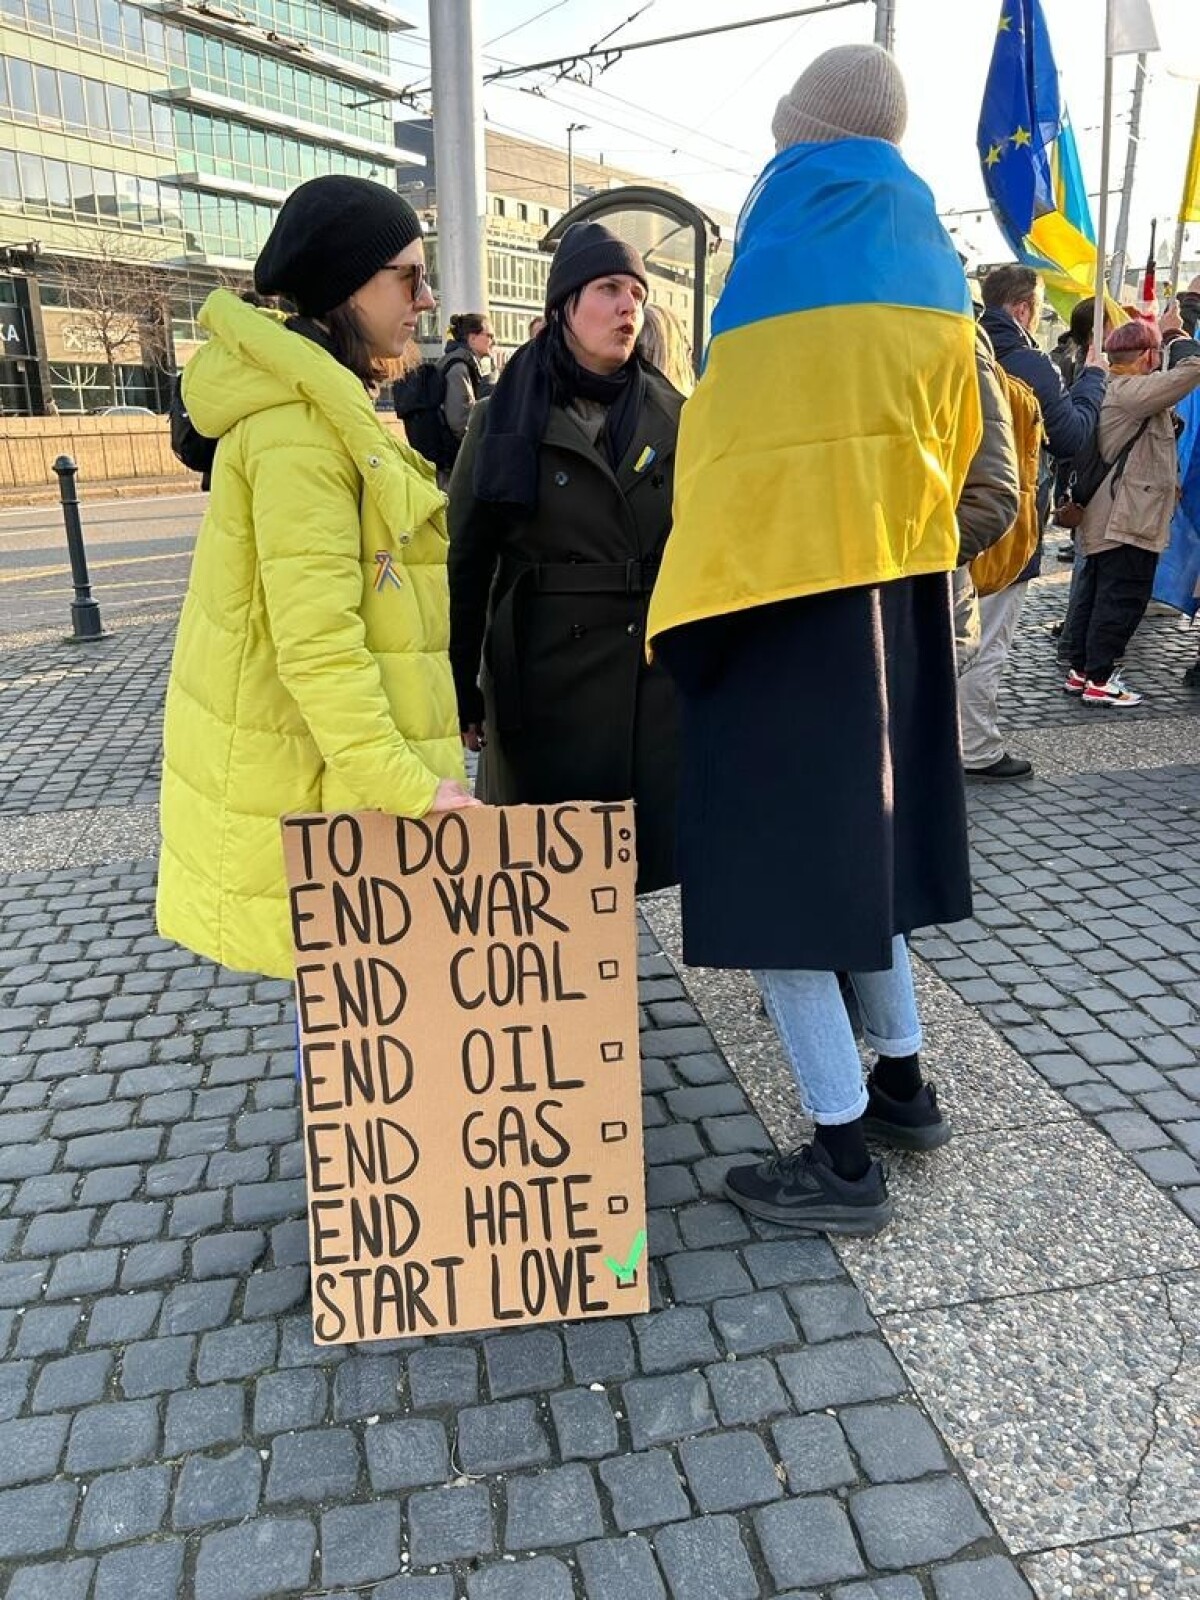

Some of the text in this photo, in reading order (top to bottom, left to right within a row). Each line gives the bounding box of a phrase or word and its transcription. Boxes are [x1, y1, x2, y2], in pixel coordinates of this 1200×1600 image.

[285, 805, 632, 880] TO DO LIST:
[289, 870, 570, 951] END WAR
[296, 940, 588, 1034] END COAL
[302, 1024, 586, 1112] END OIL
[307, 1099, 571, 1192] END GAS
[310, 1174, 598, 1266] END HATE
[314, 1244, 609, 1342] START LOVE
